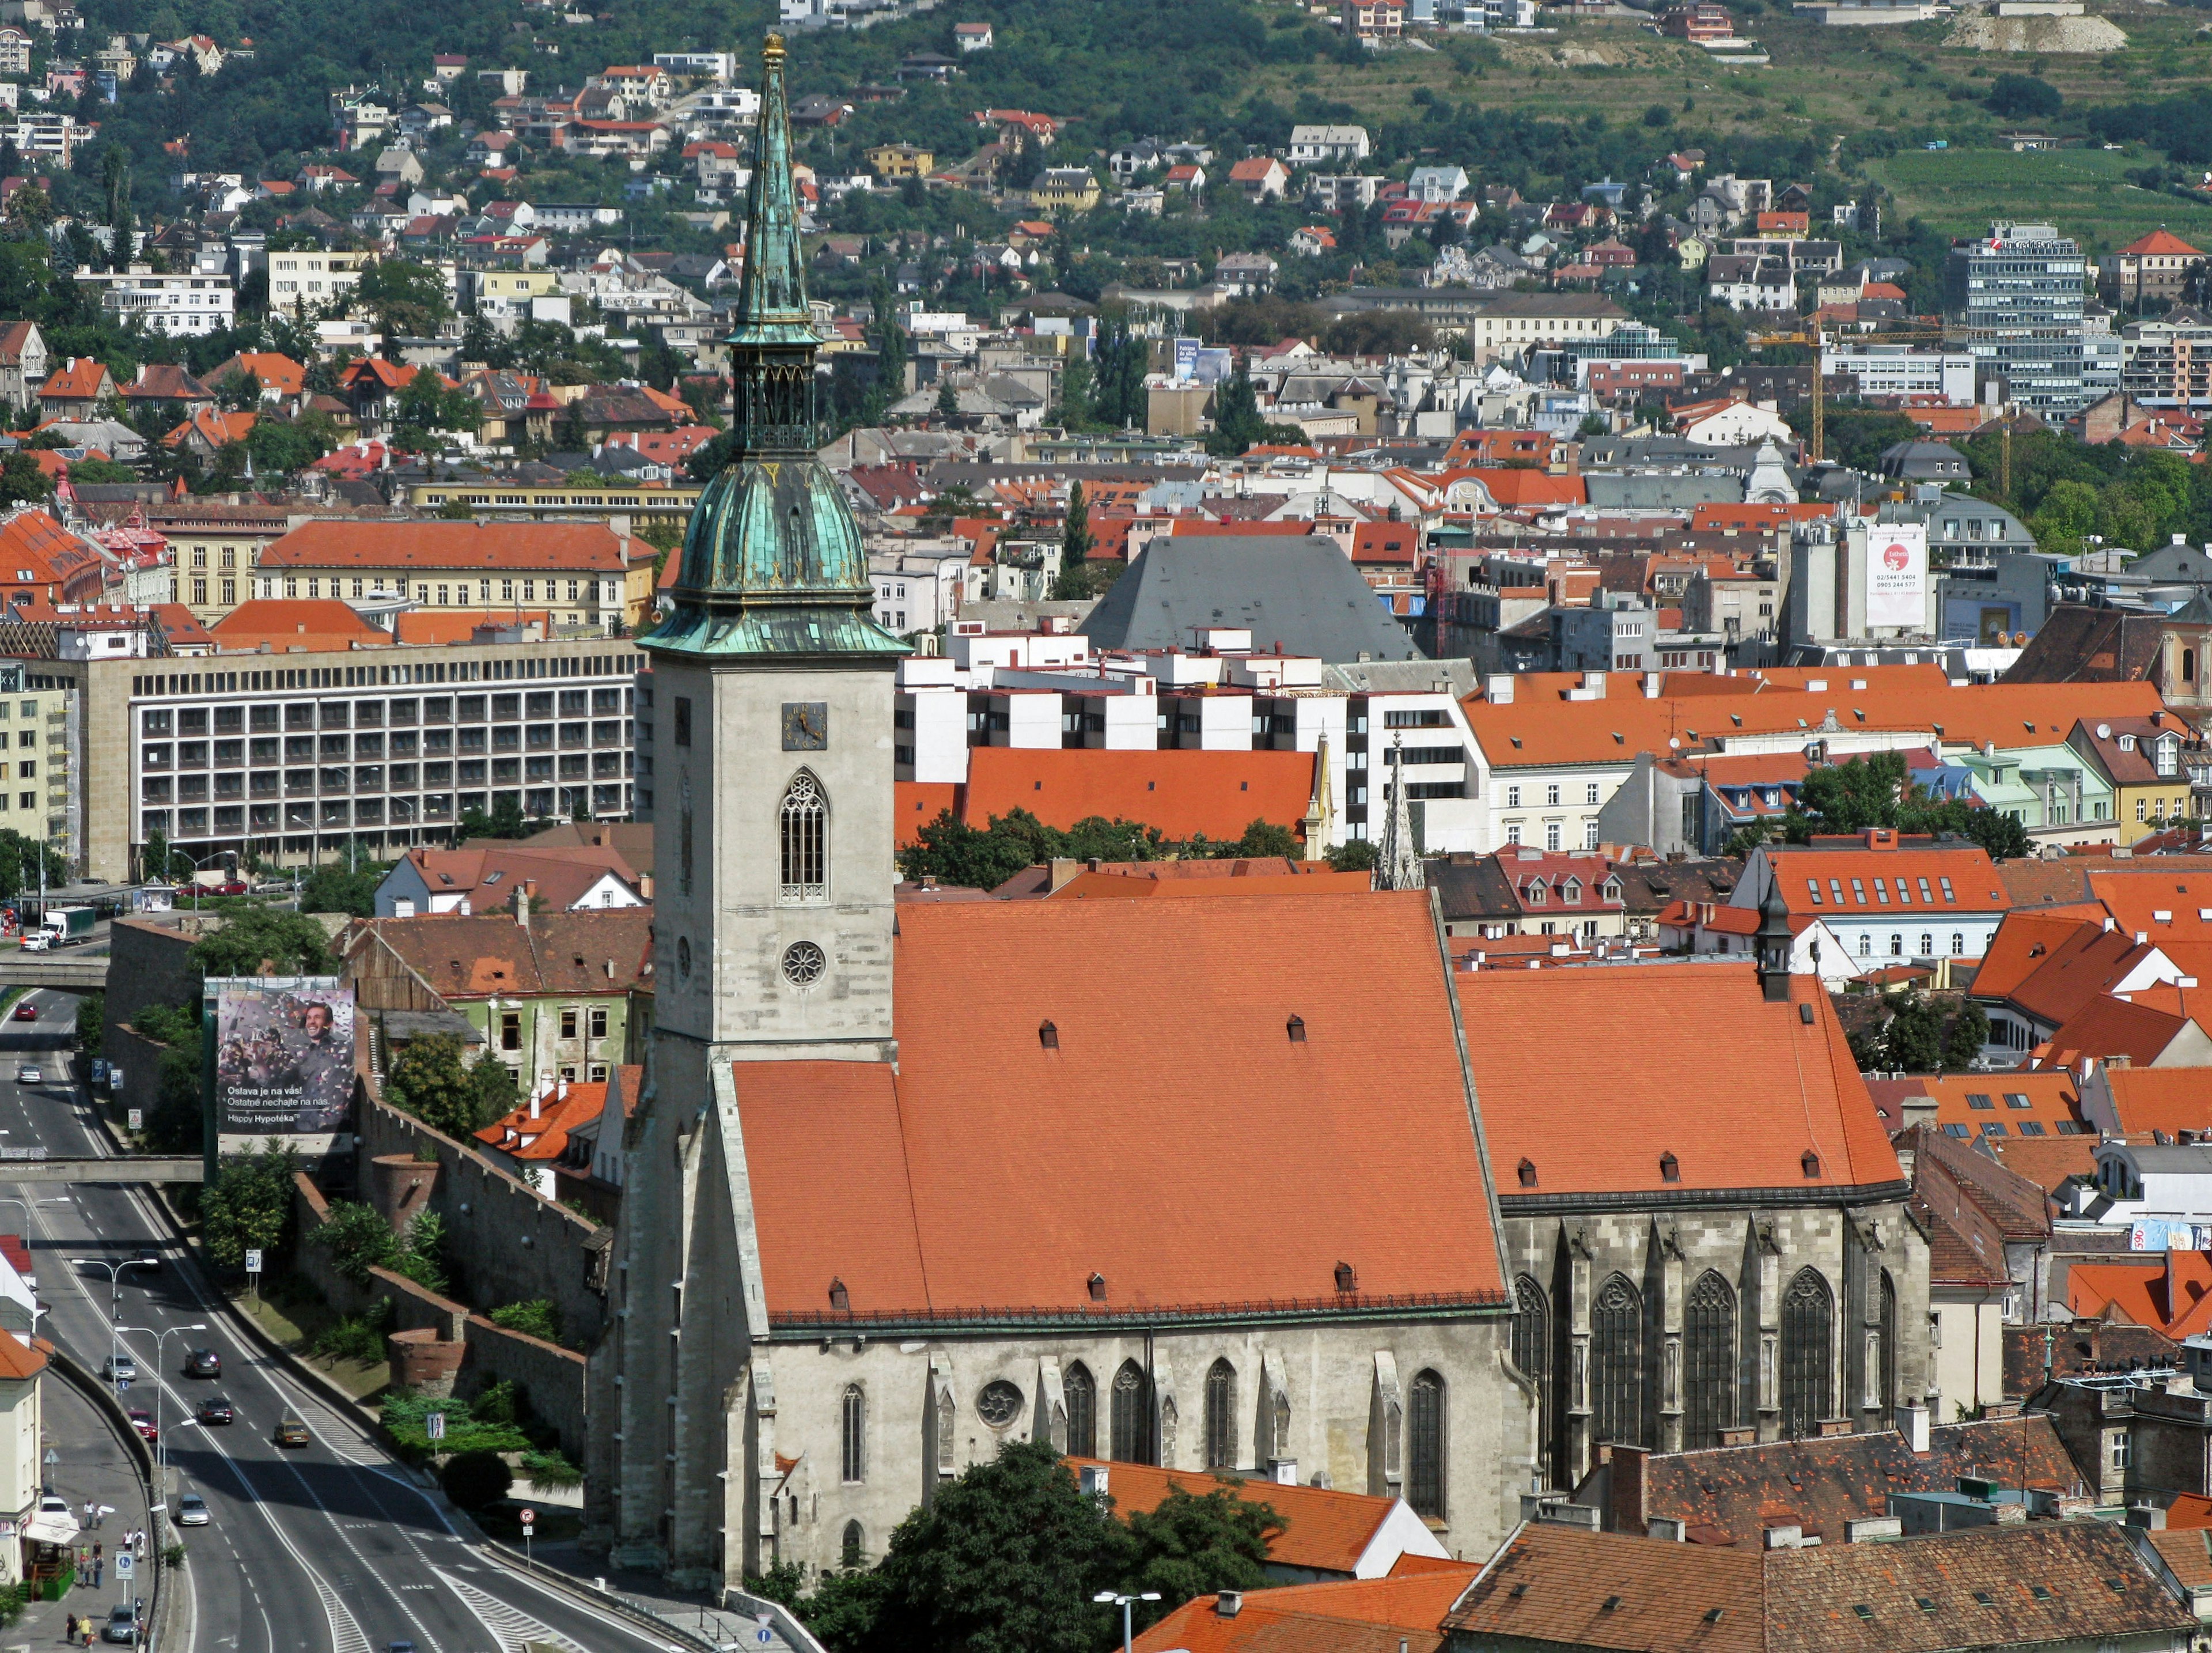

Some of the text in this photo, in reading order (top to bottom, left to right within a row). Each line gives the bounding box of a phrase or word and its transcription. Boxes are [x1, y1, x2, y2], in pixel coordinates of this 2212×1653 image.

[2003, 240, 2056, 248] UniCredit Bank
[227, 1086, 258, 1095] Oslava
[259, 1087, 268, 1097] je
[284, 1084, 302, 1095] vás!
[227, 1098, 260, 1107] Ostatné
[262, 1098, 298, 1107] nechajte
[312, 1097, 330, 1106] nás.
[228, 1114, 253, 1124] Happy
